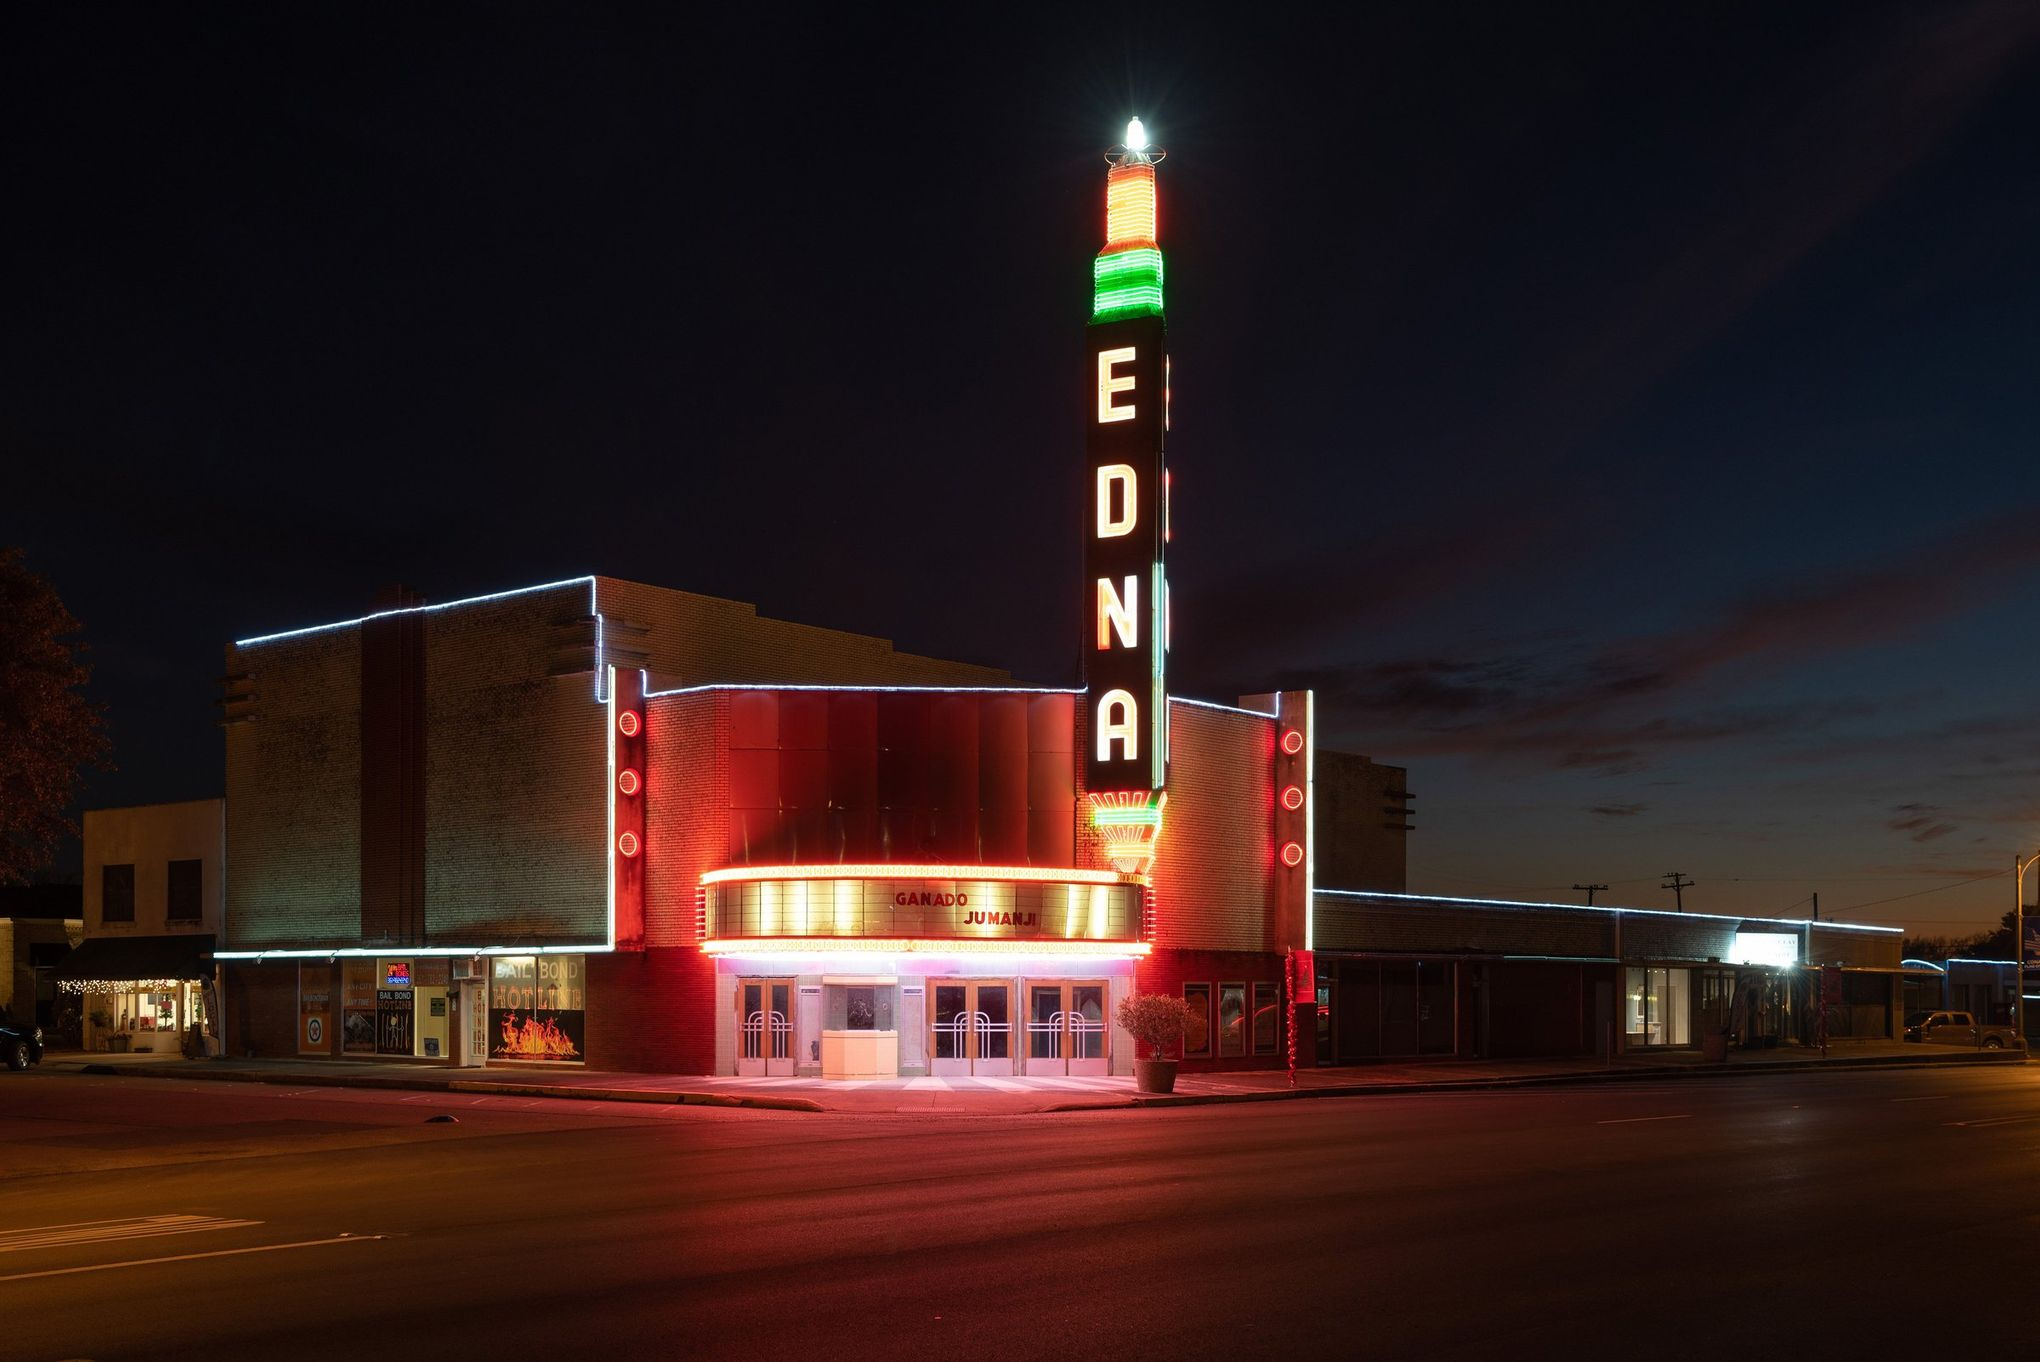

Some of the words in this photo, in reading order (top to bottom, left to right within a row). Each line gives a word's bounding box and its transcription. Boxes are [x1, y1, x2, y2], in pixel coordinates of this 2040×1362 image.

[1096, 346, 1138, 762] EDNA
[896, 892, 968, 907] GANADO
[964, 911, 1036, 926] JUMANJI
[495, 962, 533, 979] BAIL
[540, 961, 578, 979] BOND
[379, 991, 392, 999] BAIL
[394, 991, 411, 999] BOND
[378, 1000, 412, 1010] HOTLINE
